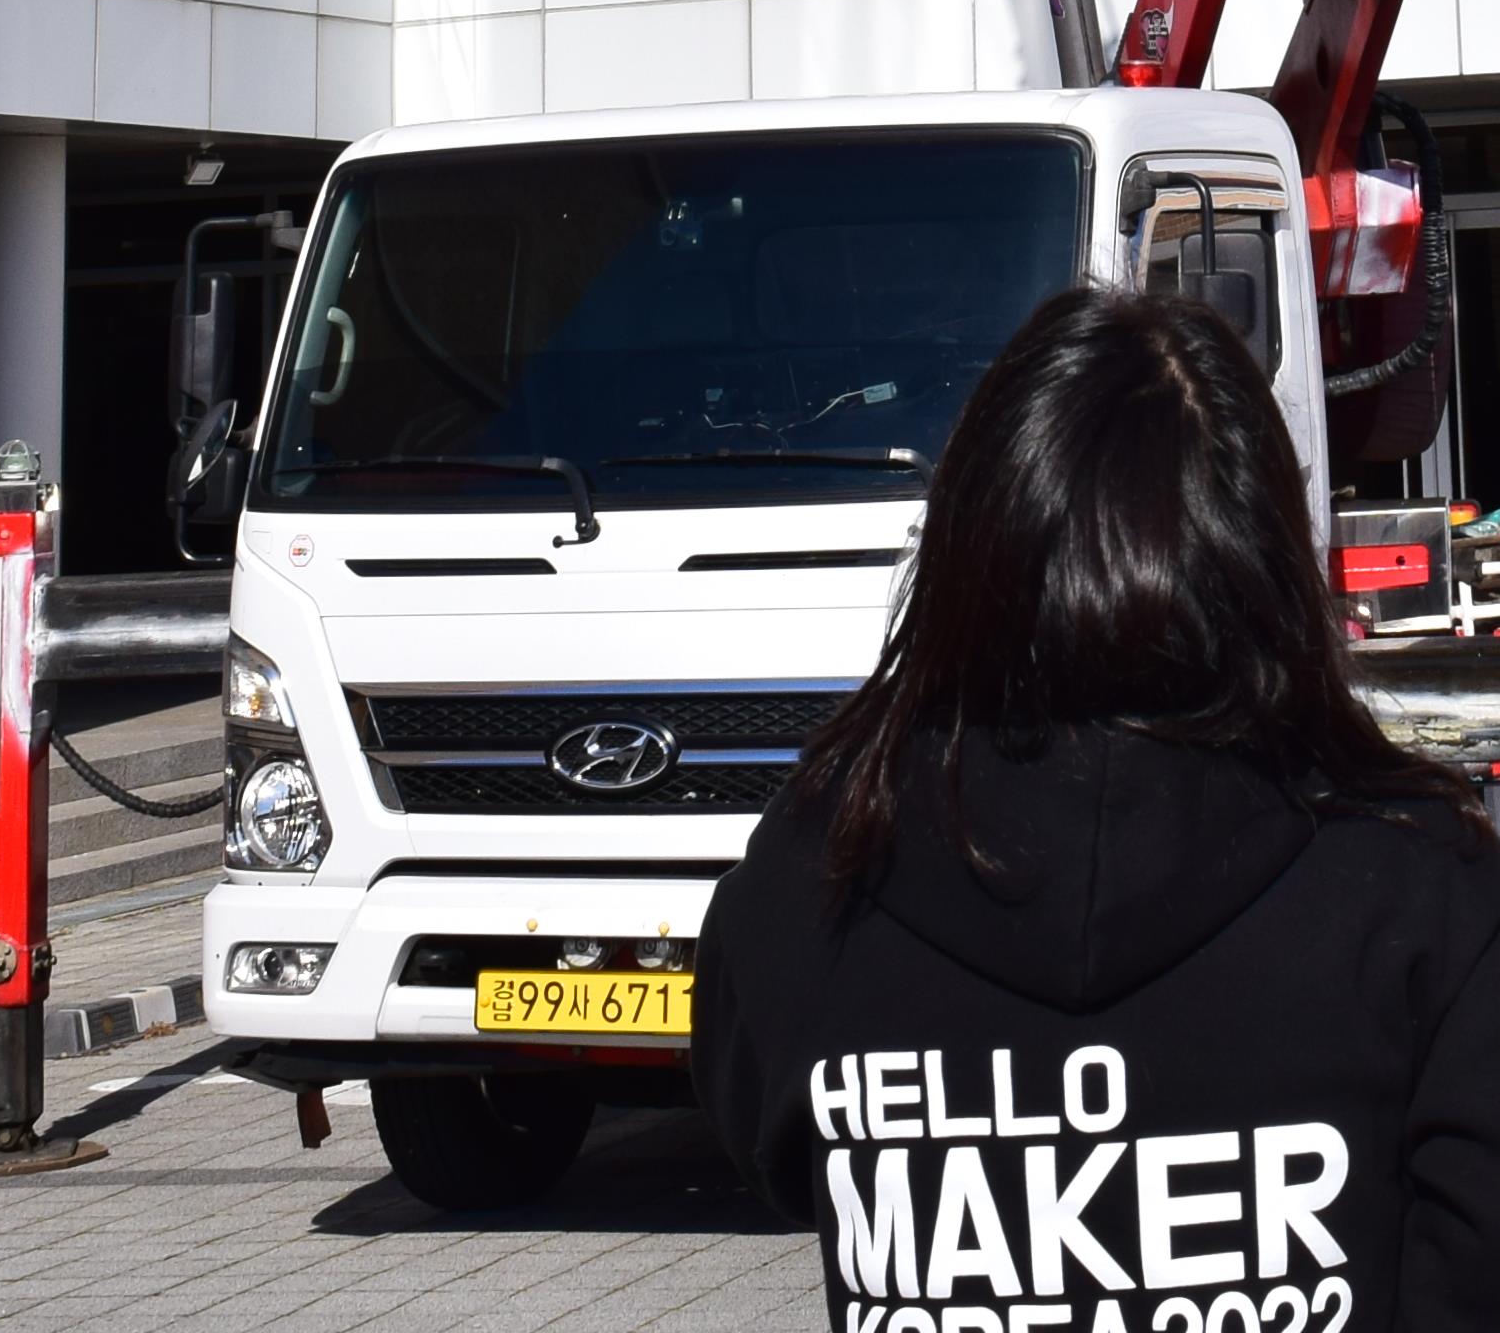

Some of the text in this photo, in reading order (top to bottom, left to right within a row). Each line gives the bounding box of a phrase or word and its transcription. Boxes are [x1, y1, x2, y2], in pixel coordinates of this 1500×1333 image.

[492, 979, 514, 1022] 경남
[518, 980, 590, 1022] 99사
[810, 1045, 1127, 1140] HELLO
[826, 1121, 1349, 1299] MAKER
